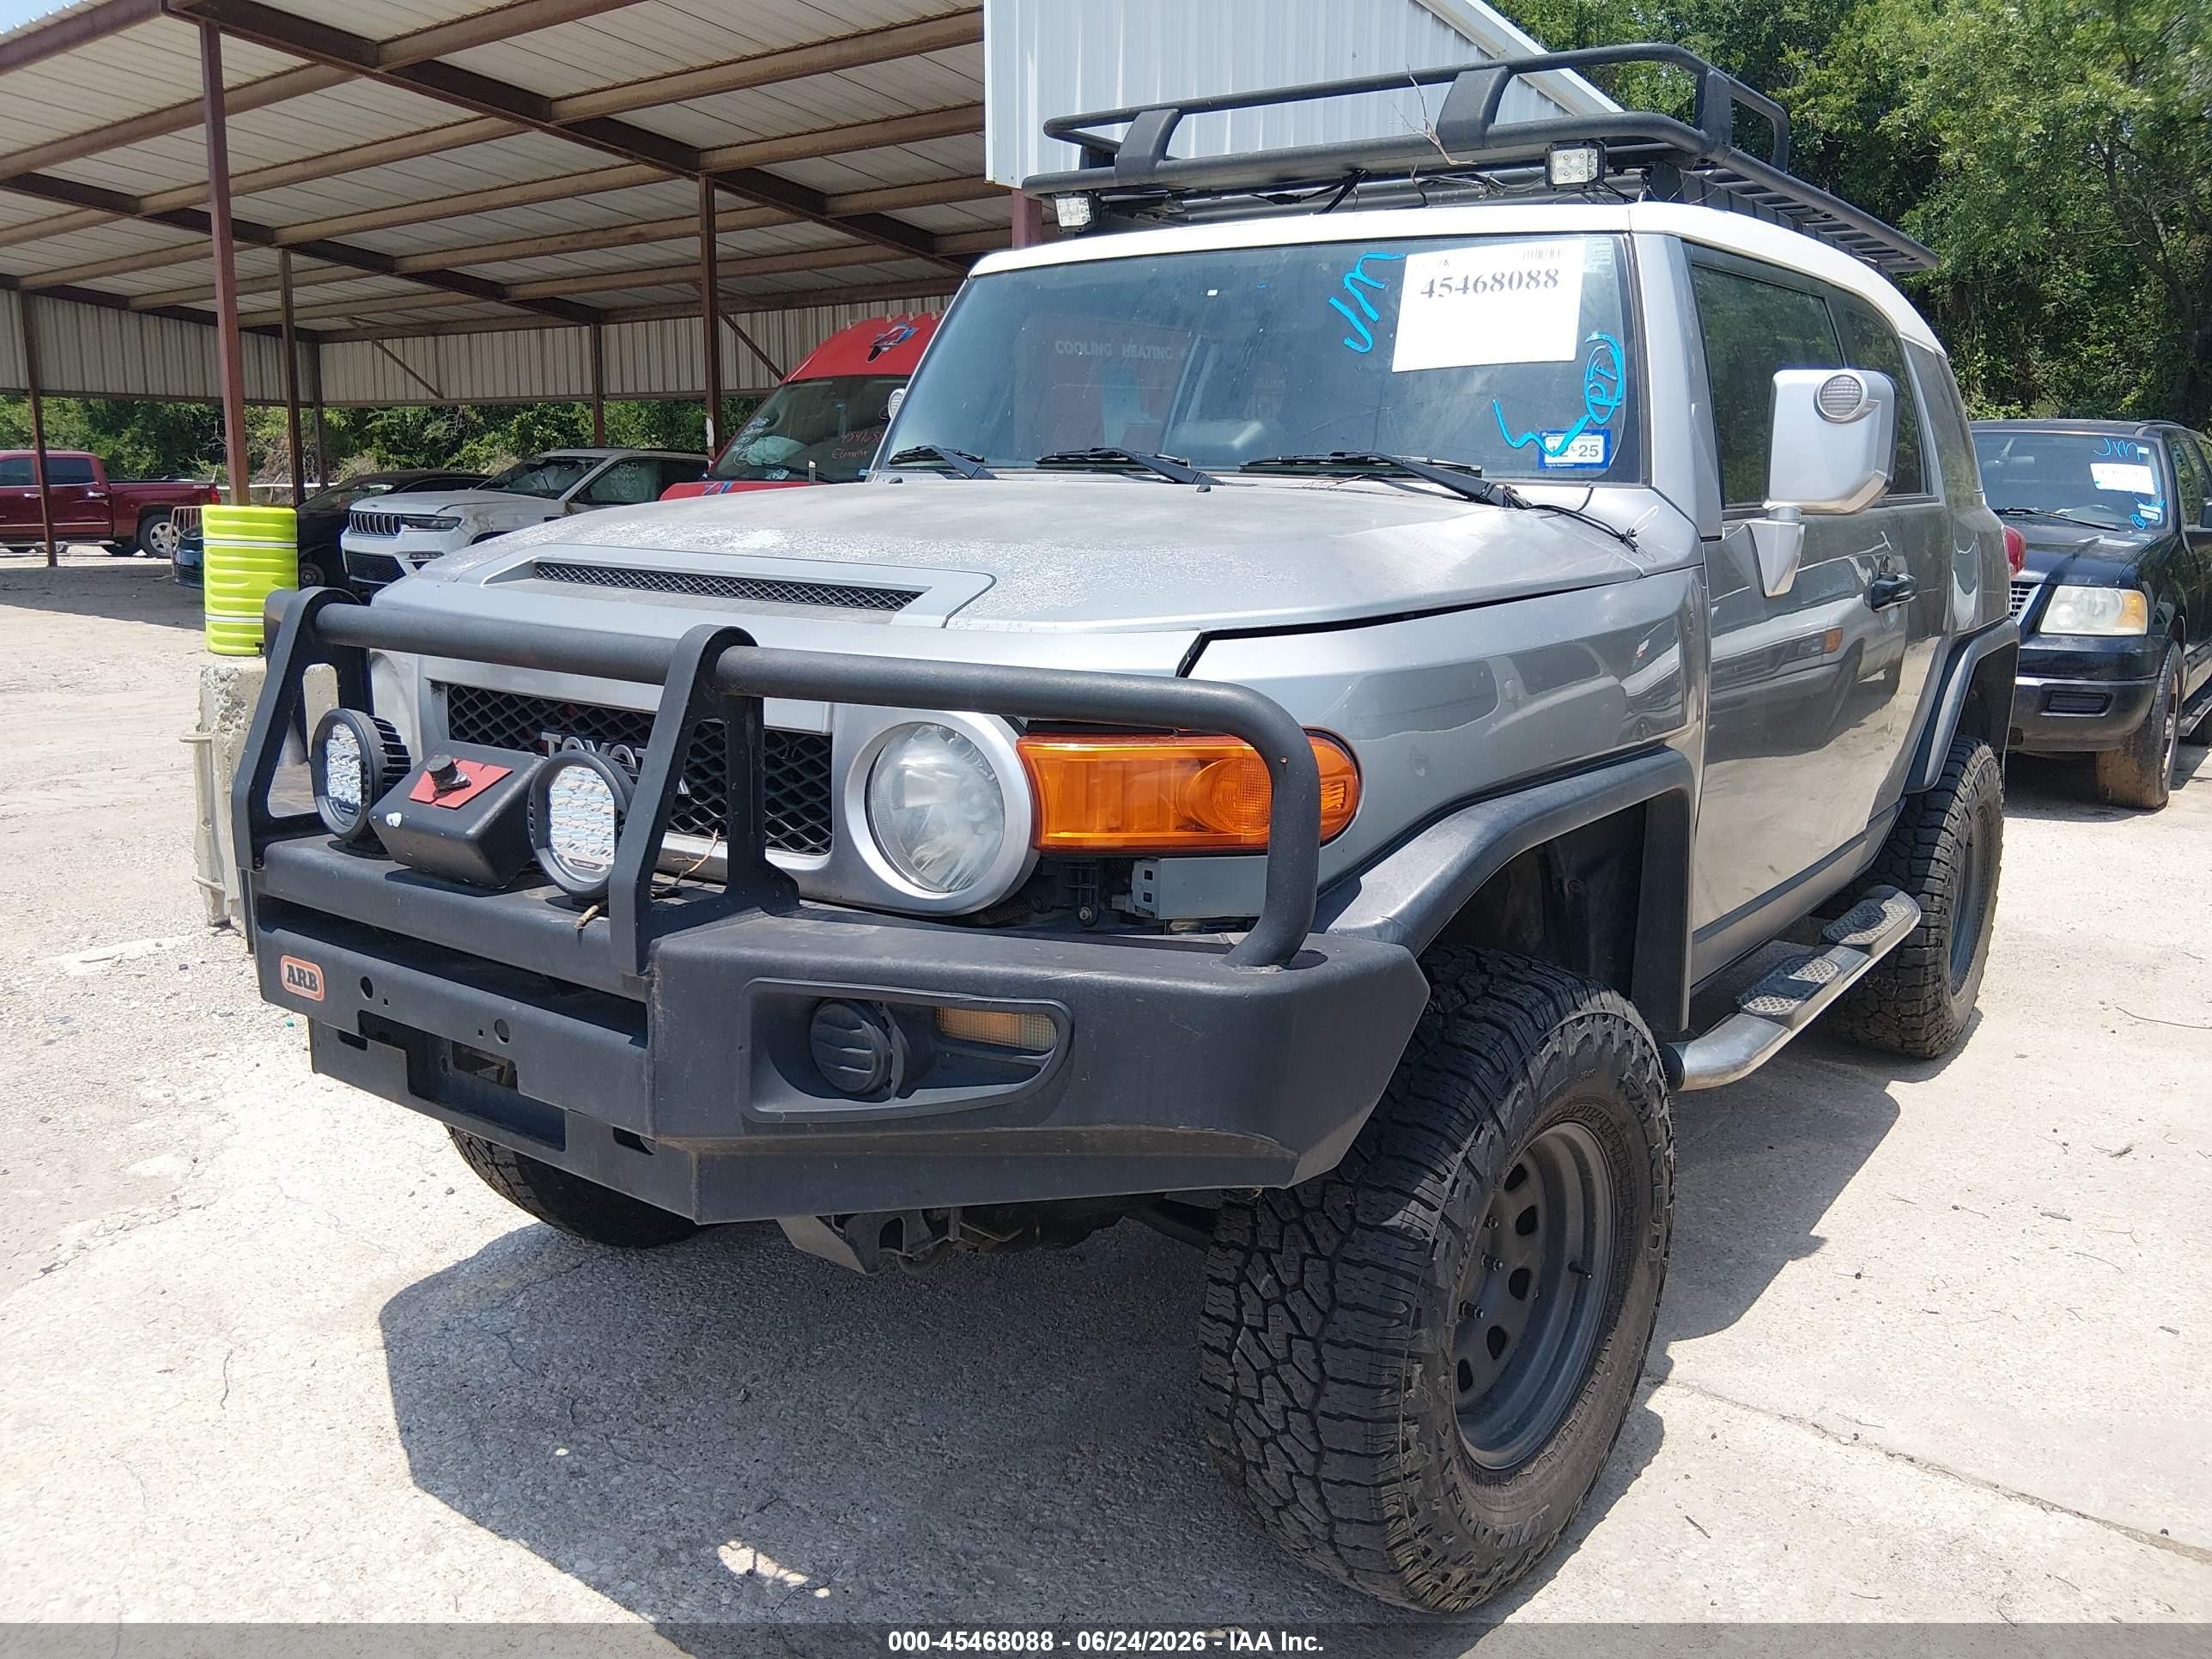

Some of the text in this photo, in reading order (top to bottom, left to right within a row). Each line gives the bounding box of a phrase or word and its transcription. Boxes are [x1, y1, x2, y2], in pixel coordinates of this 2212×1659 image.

[1420, 268, 1559, 299] 45468088
[1055, 340, 1112, 357] COOLING
[1122, 343, 1173, 359] HEATING
[1578, 445, 1599, 458] 25
[287, 964, 318, 992] ARB
